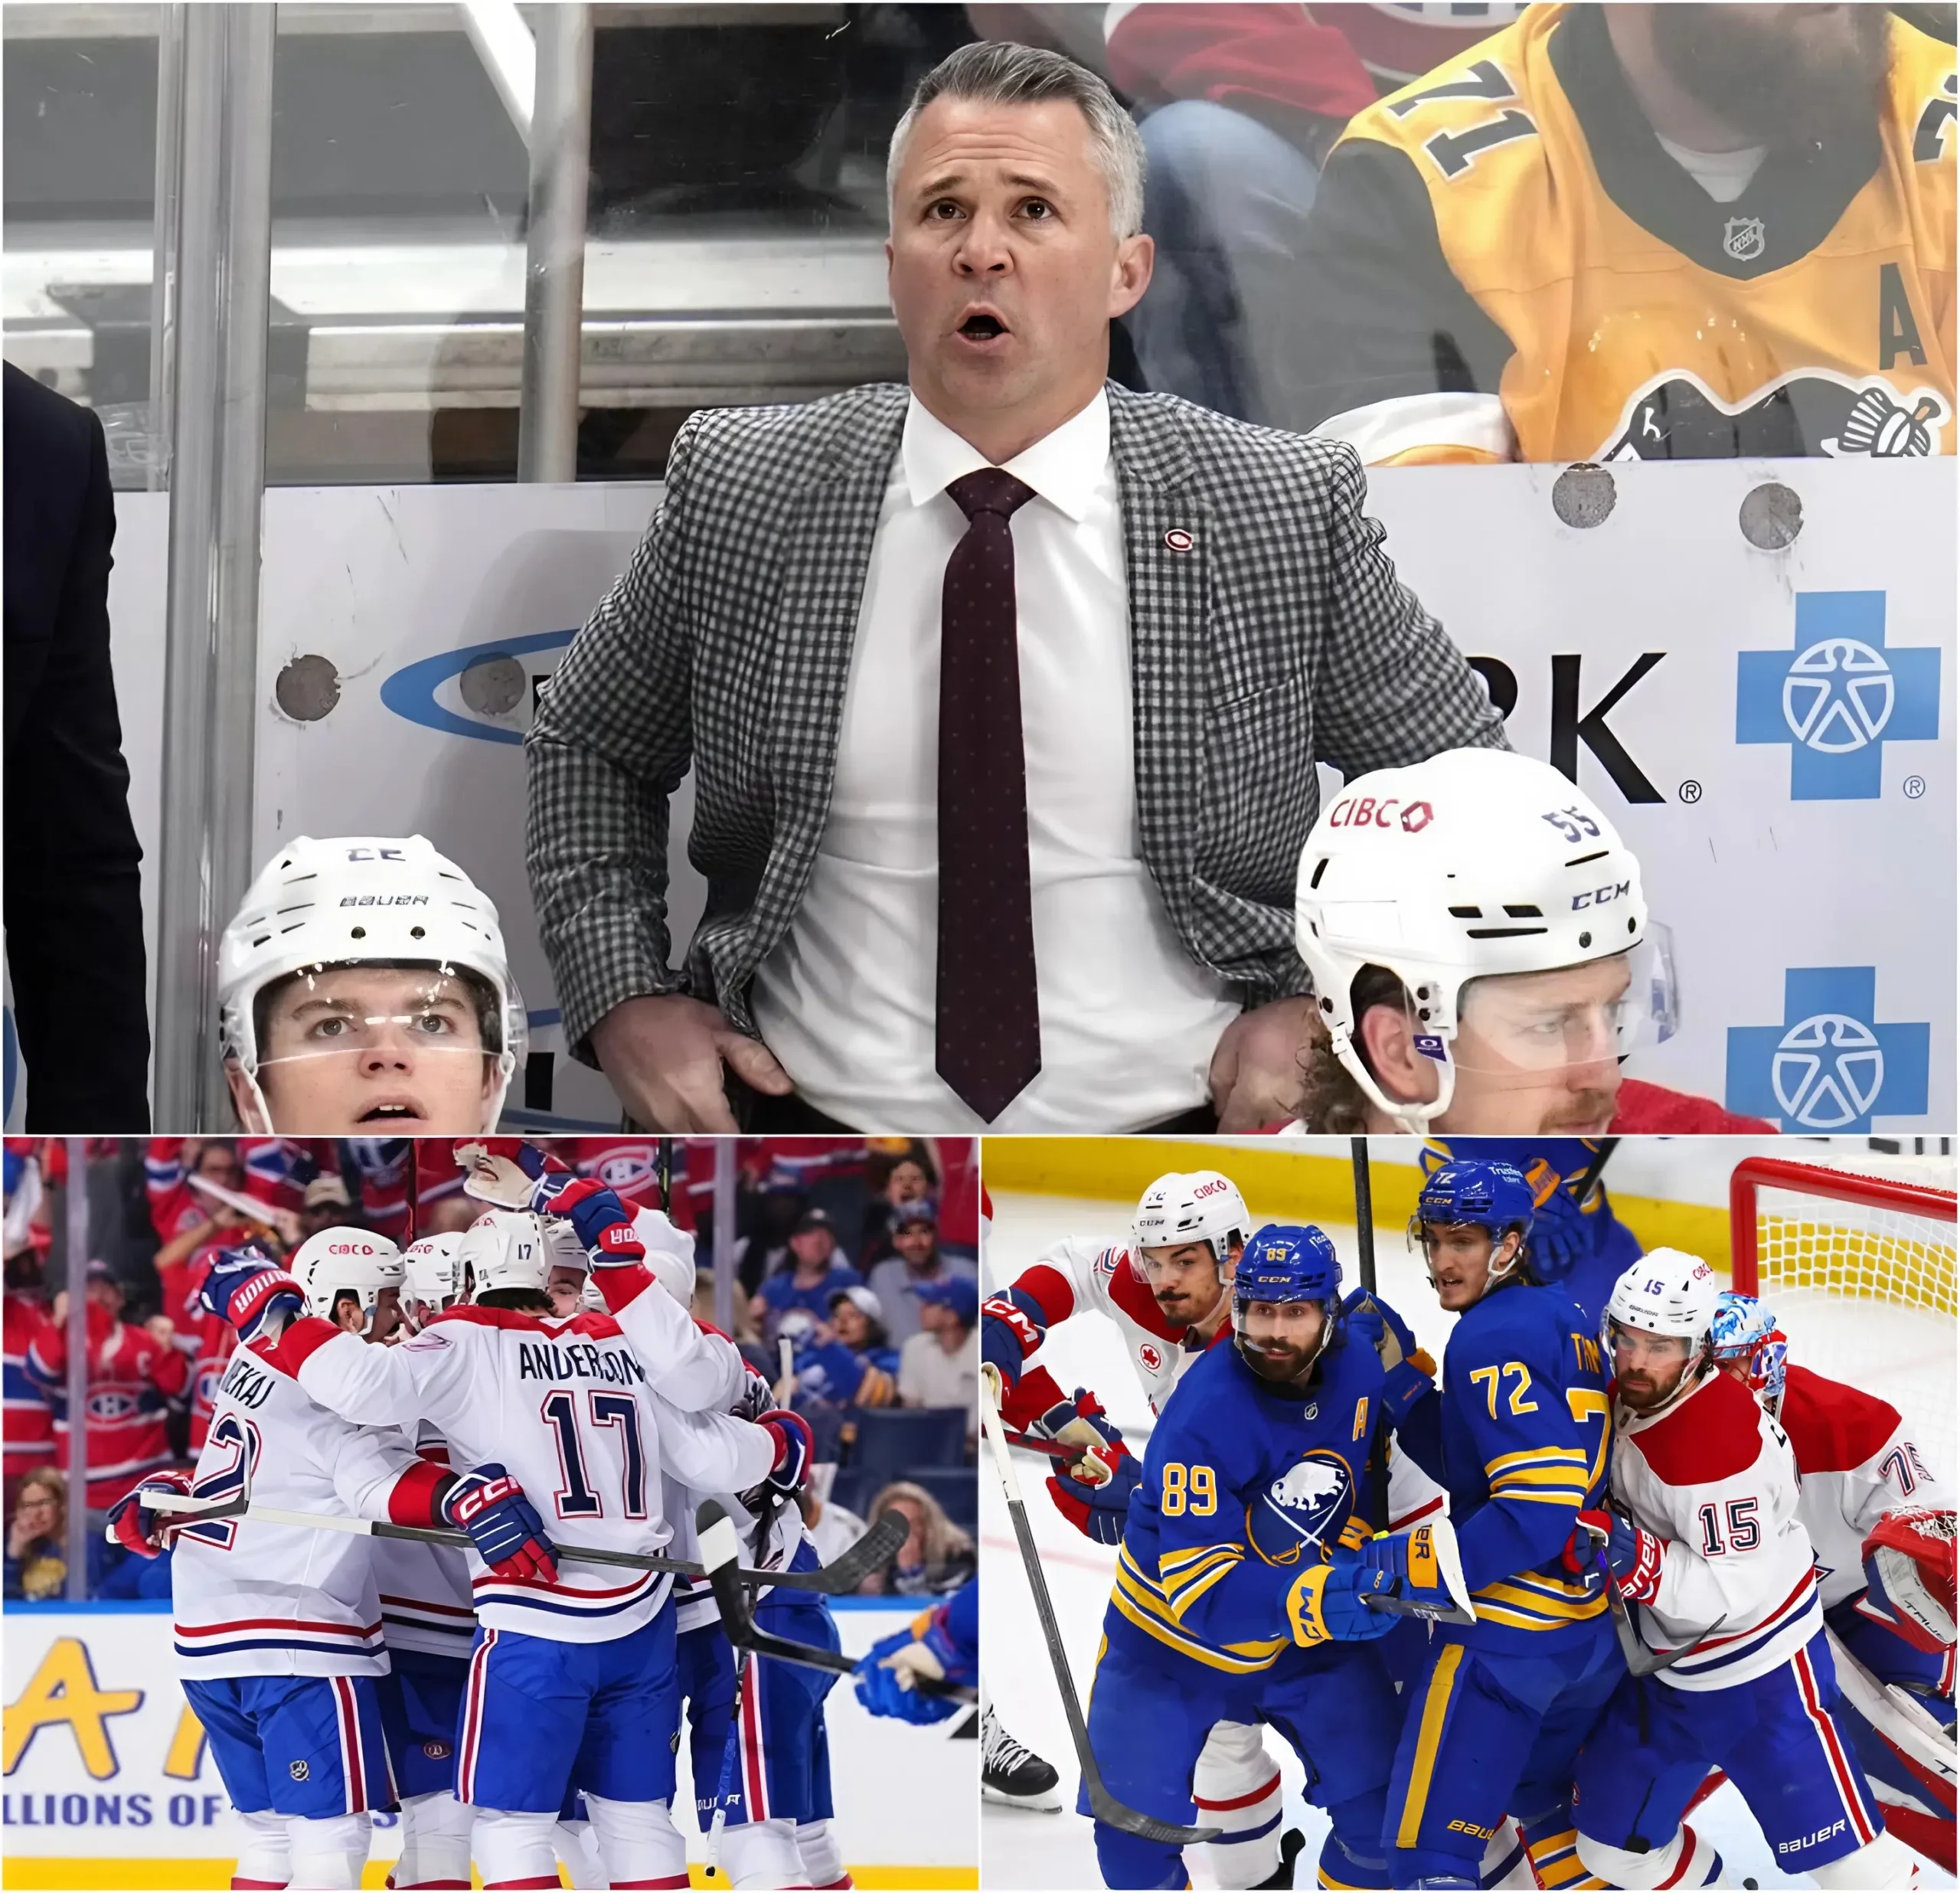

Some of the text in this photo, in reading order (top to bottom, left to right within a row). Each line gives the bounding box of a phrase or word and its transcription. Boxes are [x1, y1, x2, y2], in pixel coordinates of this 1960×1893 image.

[1385, 59, 1540, 179] 71
[1879, 262, 1929, 371] A
[1330, 798, 1399, 828] CIBC
[1541, 806, 1601, 843] 55
[1572, 880, 1631, 911] CCM
[518, 1244, 532, 1260] 17
[1644, 1279, 1665, 1296] 15
[1469, 1361, 1539, 1421] 72
[1352, 1397, 1368, 1441] A
[541, 1389, 647, 1520] 17
[1161, 1463, 1217, 1516] 89
[1698, 1496, 1761, 1557] 15
[168, 1793, 223, 1827] OF
[1779, 1818, 1846, 1854] BAUER
